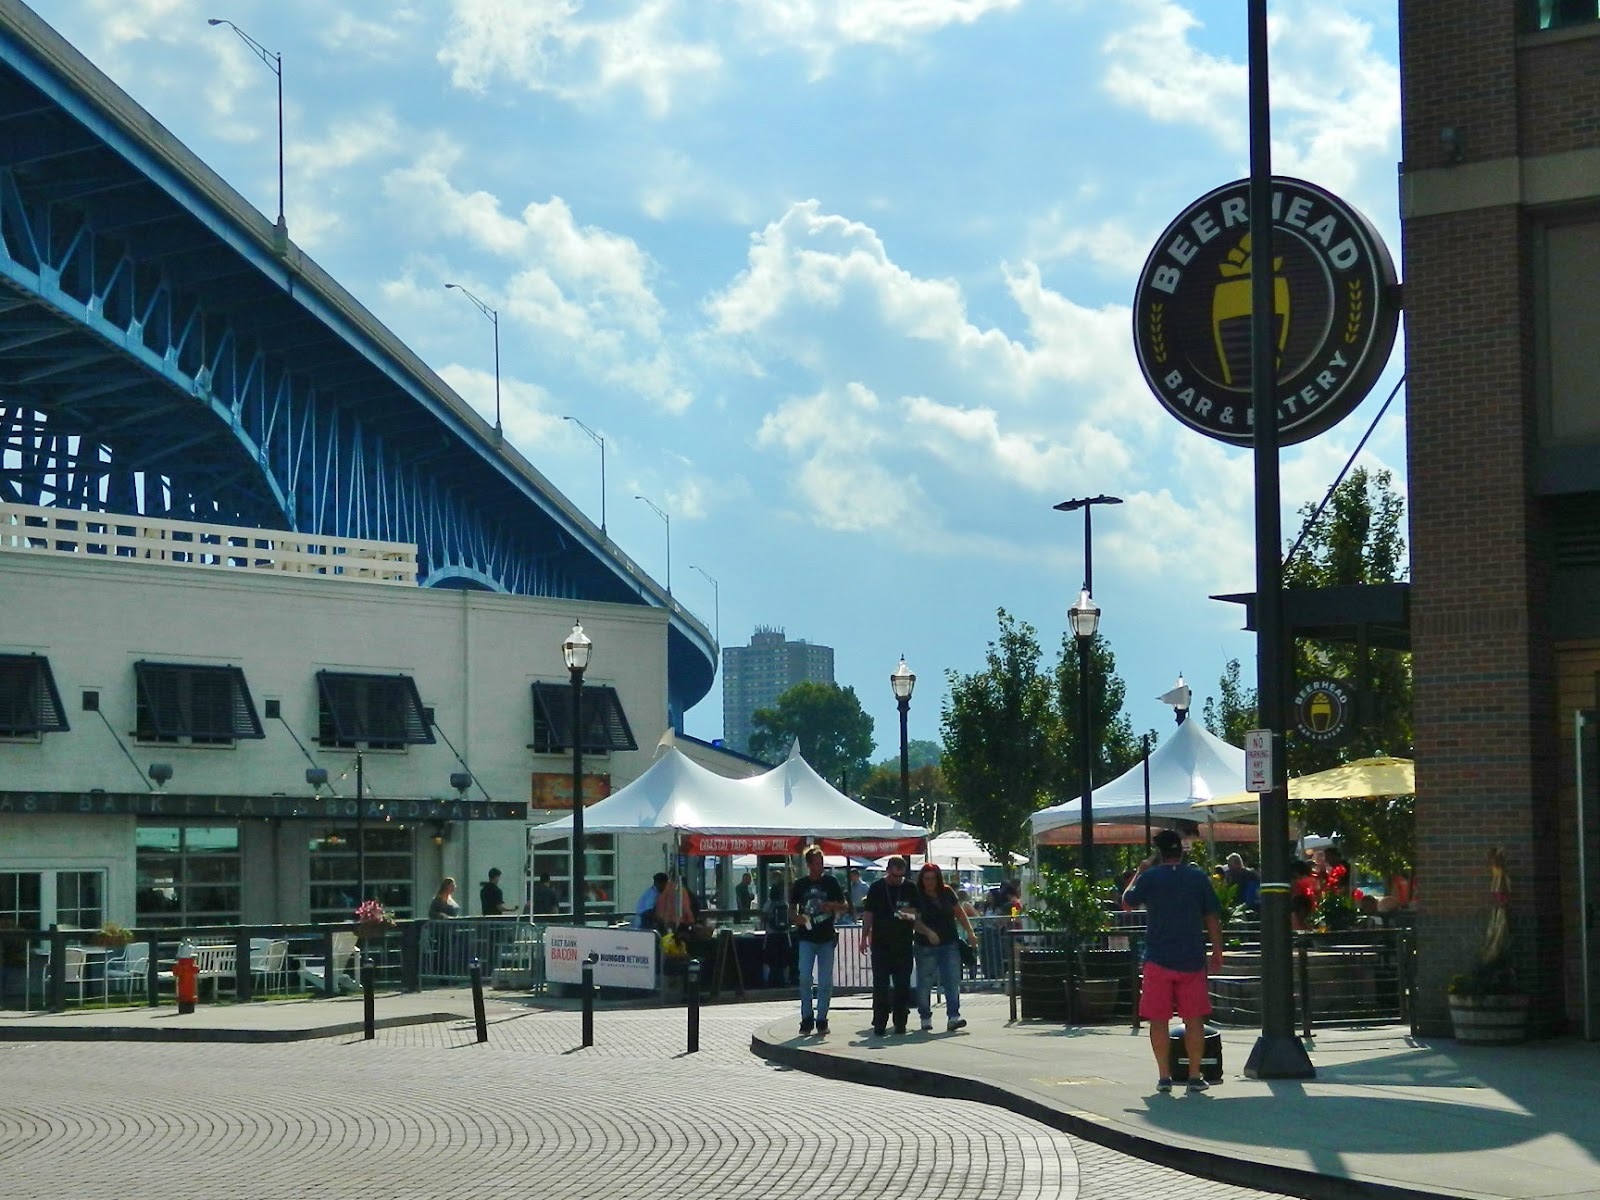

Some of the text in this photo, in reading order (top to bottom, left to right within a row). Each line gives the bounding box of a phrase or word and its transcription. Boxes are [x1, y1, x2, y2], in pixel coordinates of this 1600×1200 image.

[1164, 350, 1348, 425] BAR & ETERY
[1295, 681, 1347, 705] BEERHEAD
[1253, 737, 1264, 749] NO
[1247, 750, 1270, 758] PARKING
[1253, 760, 1263, 769] ANY
[78, 795, 163, 813] BANK
[700, 838, 728, 851] COASTAL
[730, 839, 747, 851] TACO
[752, 839, 765, 851] BAR
[551, 939, 577, 947] EAST BANK
[551, 948, 577, 960] BACON
[600, 954, 649, 964] HUNGER NETWORK
